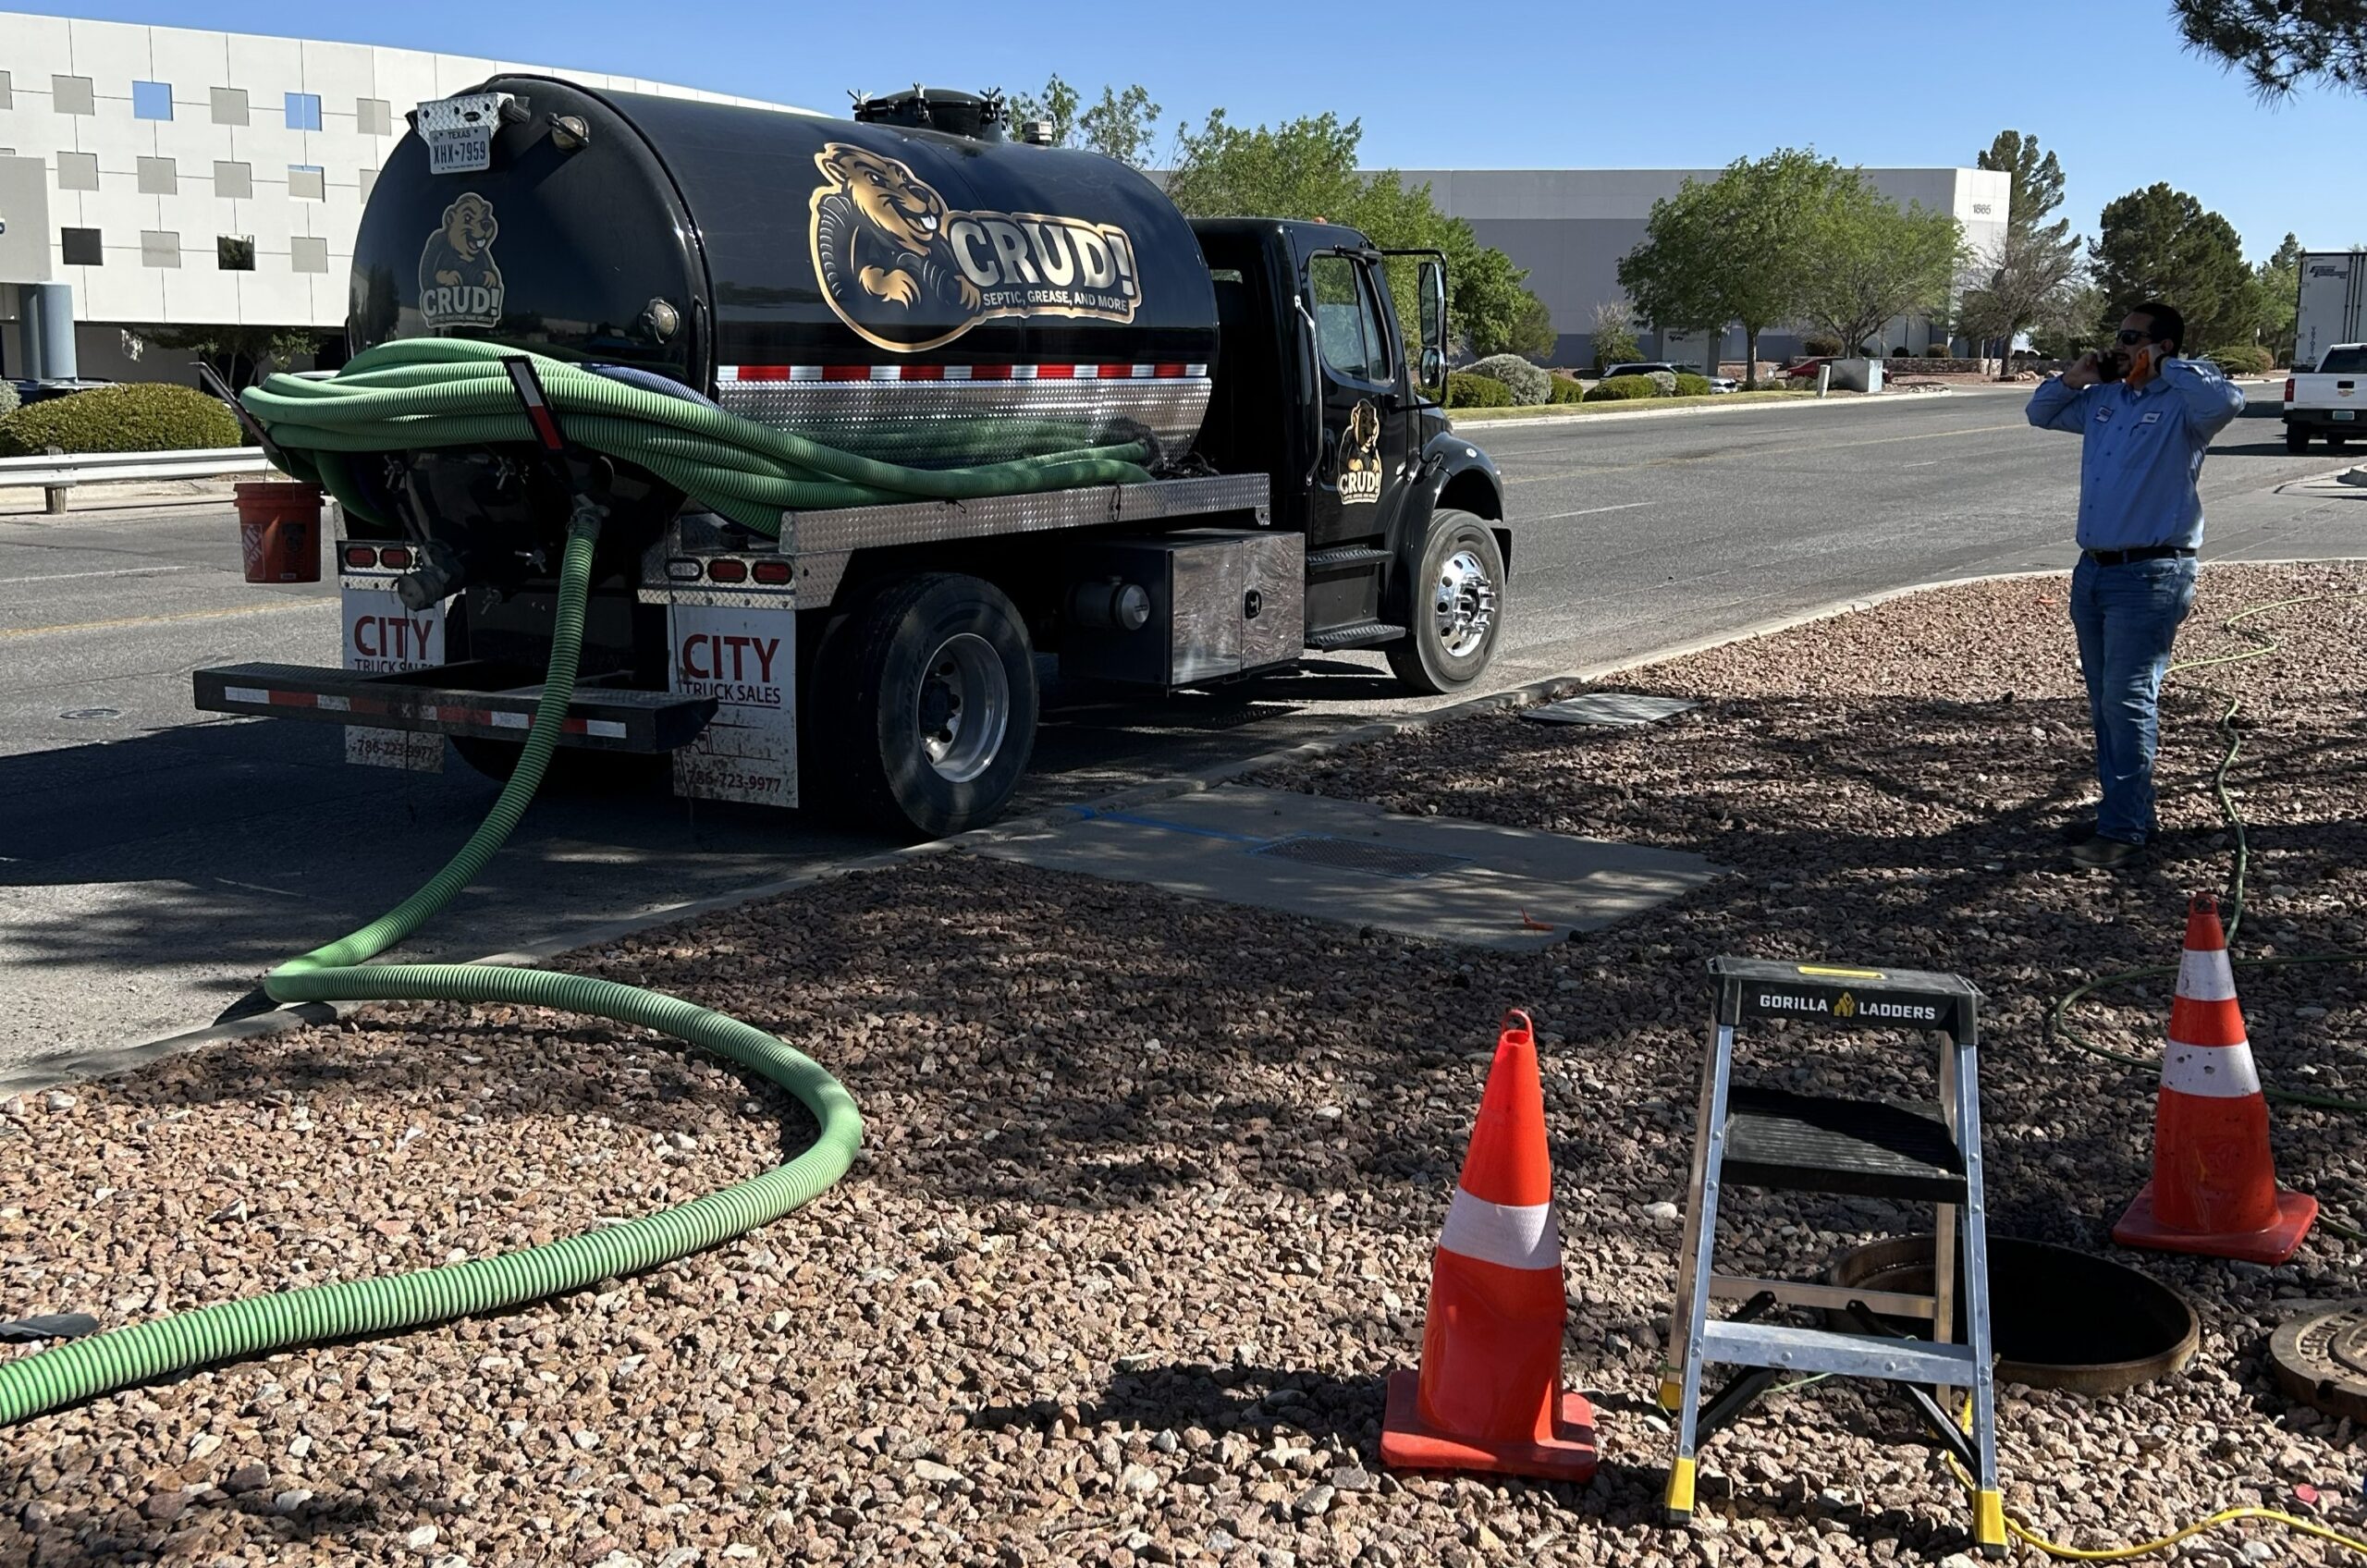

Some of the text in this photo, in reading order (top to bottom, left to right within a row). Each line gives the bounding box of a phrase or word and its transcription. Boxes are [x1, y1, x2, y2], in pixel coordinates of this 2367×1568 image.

[448, 130, 471, 140] TEXAS
[950, 220, 1136, 297] CRUD!
[423, 286, 500, 316] CRUD!
[982, 289, 1128, 312] SEPTIC, GREASE, AND MORE
[1339, 471, 1380, 496] CRUD!
[353, 615, 434, 660] CITY
[682, 633, 781, 683] CITY
[682, 680, 781, 704] TRUCK SALES
[1760, 994, 1936, 1021] GORILLA LADDERS
